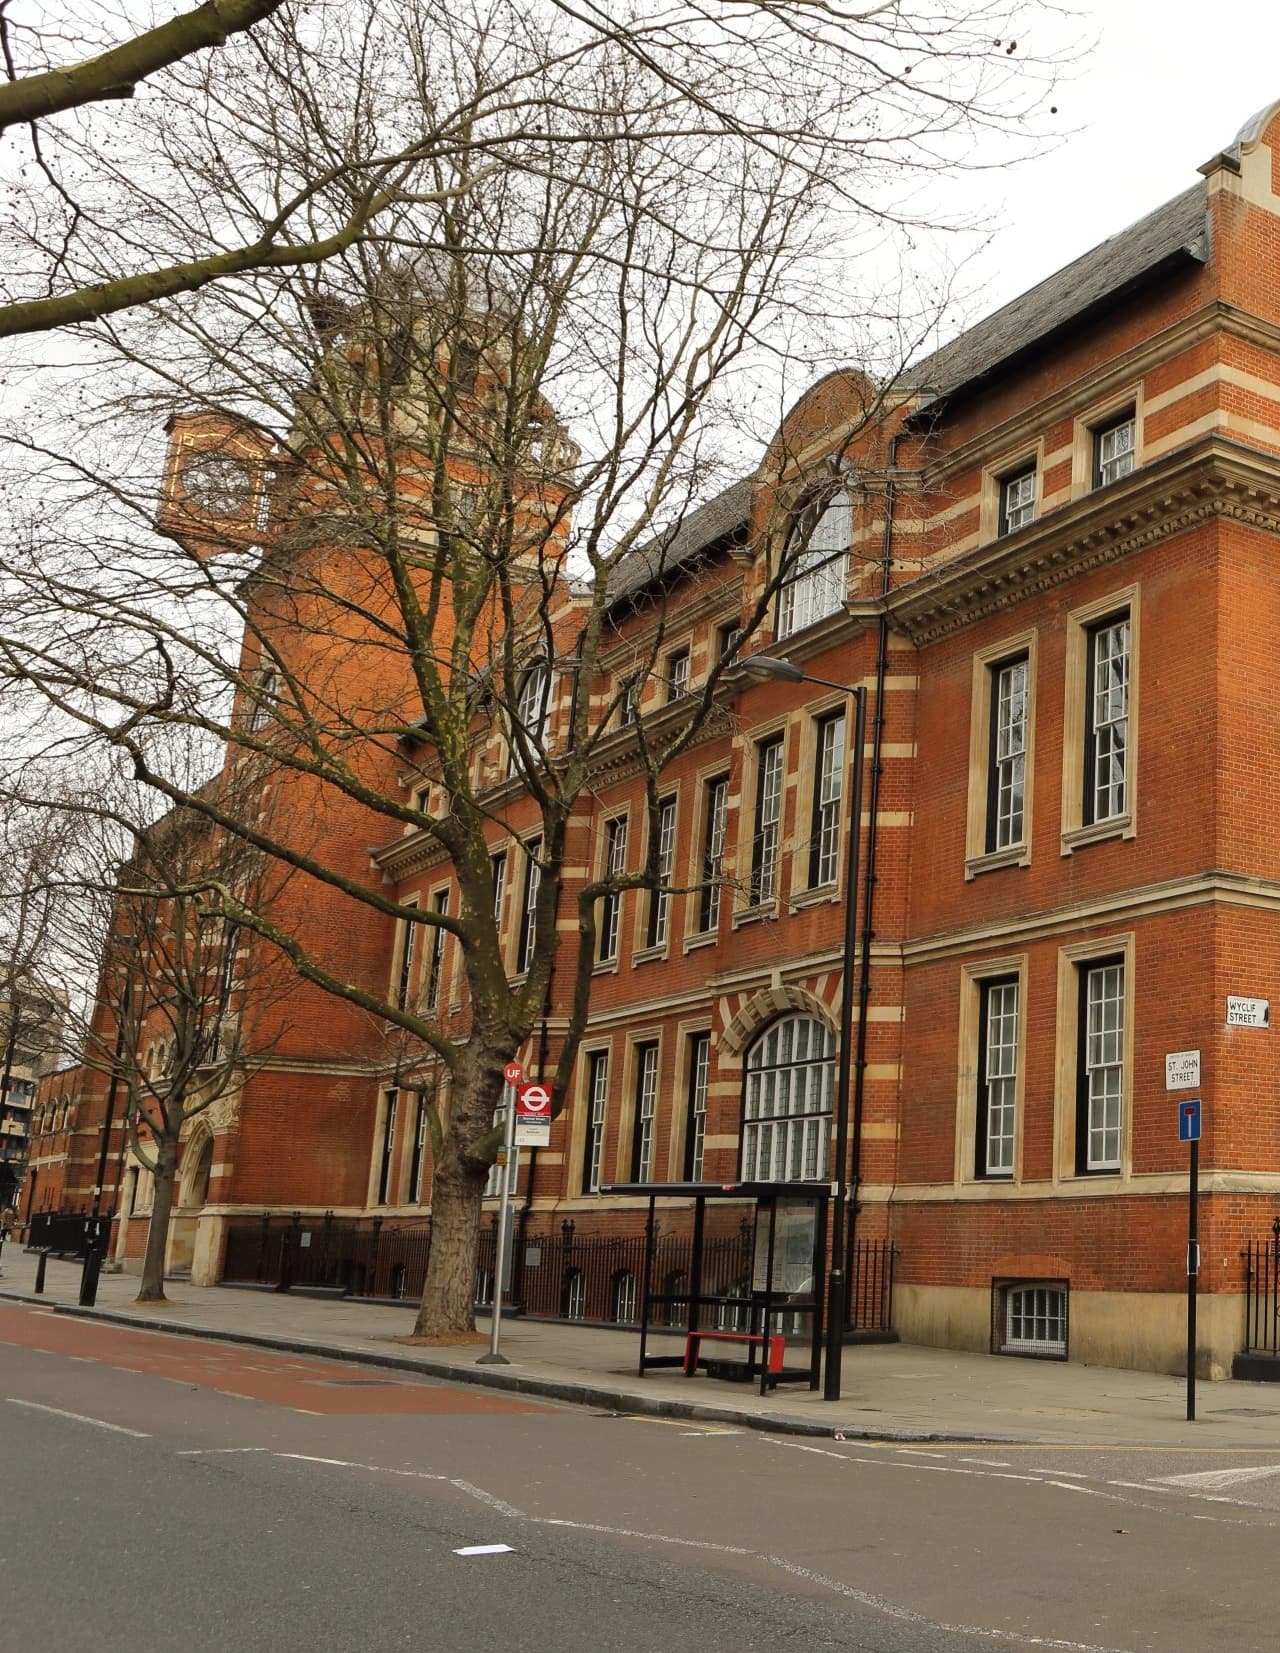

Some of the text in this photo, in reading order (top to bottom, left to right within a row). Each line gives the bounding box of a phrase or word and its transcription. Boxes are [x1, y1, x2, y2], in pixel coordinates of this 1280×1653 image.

[1230, 1001, 1256, 1012] WYCLIF
[1230, 1012, 1256, 1023] STREET
[1181, 1059, 1198, 1070] JOHN
[507, 1069, 520, 1078] UF
[1171, 1071, 1194, 1082] STREET
